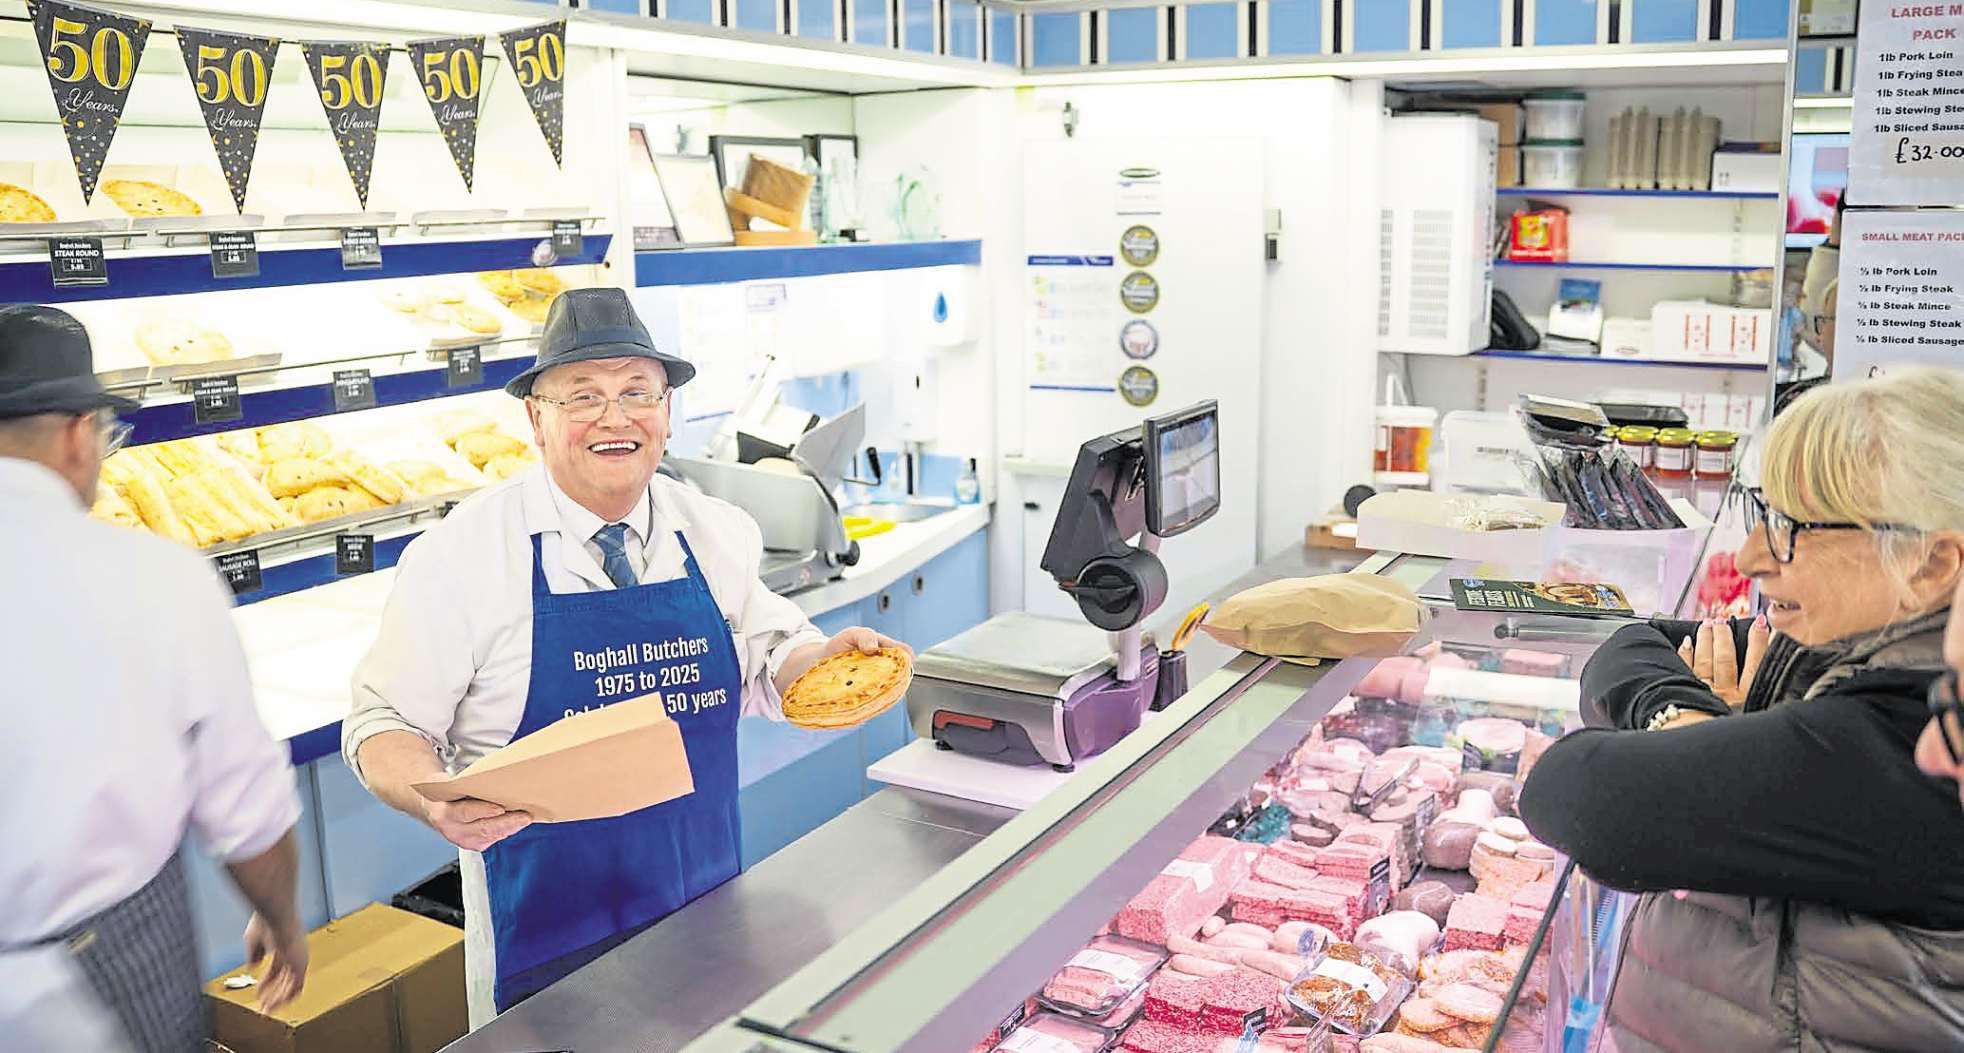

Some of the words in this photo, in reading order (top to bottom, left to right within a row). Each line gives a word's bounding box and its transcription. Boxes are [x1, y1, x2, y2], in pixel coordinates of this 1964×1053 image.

[1891, 6, 1944, 18] LARGE
[1912, 28, 1956, 40] PACK
[47, 16, 135, 91] 50
[1899, 52, 1925, 61] Pork
[1929, 51, 1953, 60] Loin
[515, 32, 565, 87] 50
[196, 44, 268, 107] 50
[424, 47, 480, 103] 50
[1897, 70, 1933, 80] Frying
[321, 54, 382, 109] 50
[1896, 88, 1929, 96] Steak
[1932, 86, 1964, 96] Mince
[1895, 106, 1941, 116] Stewing
[1894, 123, 1929, 132] Sliced
[1862, 232, 1899, 241] SMALL
[1902, 232, 1934, 241] MEAT
[1886, 268, 1910, 276] Pork
[1914, 268, 1937, 276] Loin
[1884, 285, 1918, 294] Frying
[1922, 285, 1954, 293] Steak
[1882, 320, 1926, 328] Stewing
[1930, 320, 1962, 328] Steak
[1881, 336, 1914, 344] Sliced
[574, 644, 638, 673] Boghall
[643, 636, 709, 663] Butchers
[594, 673, 635, 697] 1975
[640, 672, 656, 690] to
[660, 663, 700, 687] 2025
[666, 692, 687, 714] 50
[691, 688, 727, 714] years
